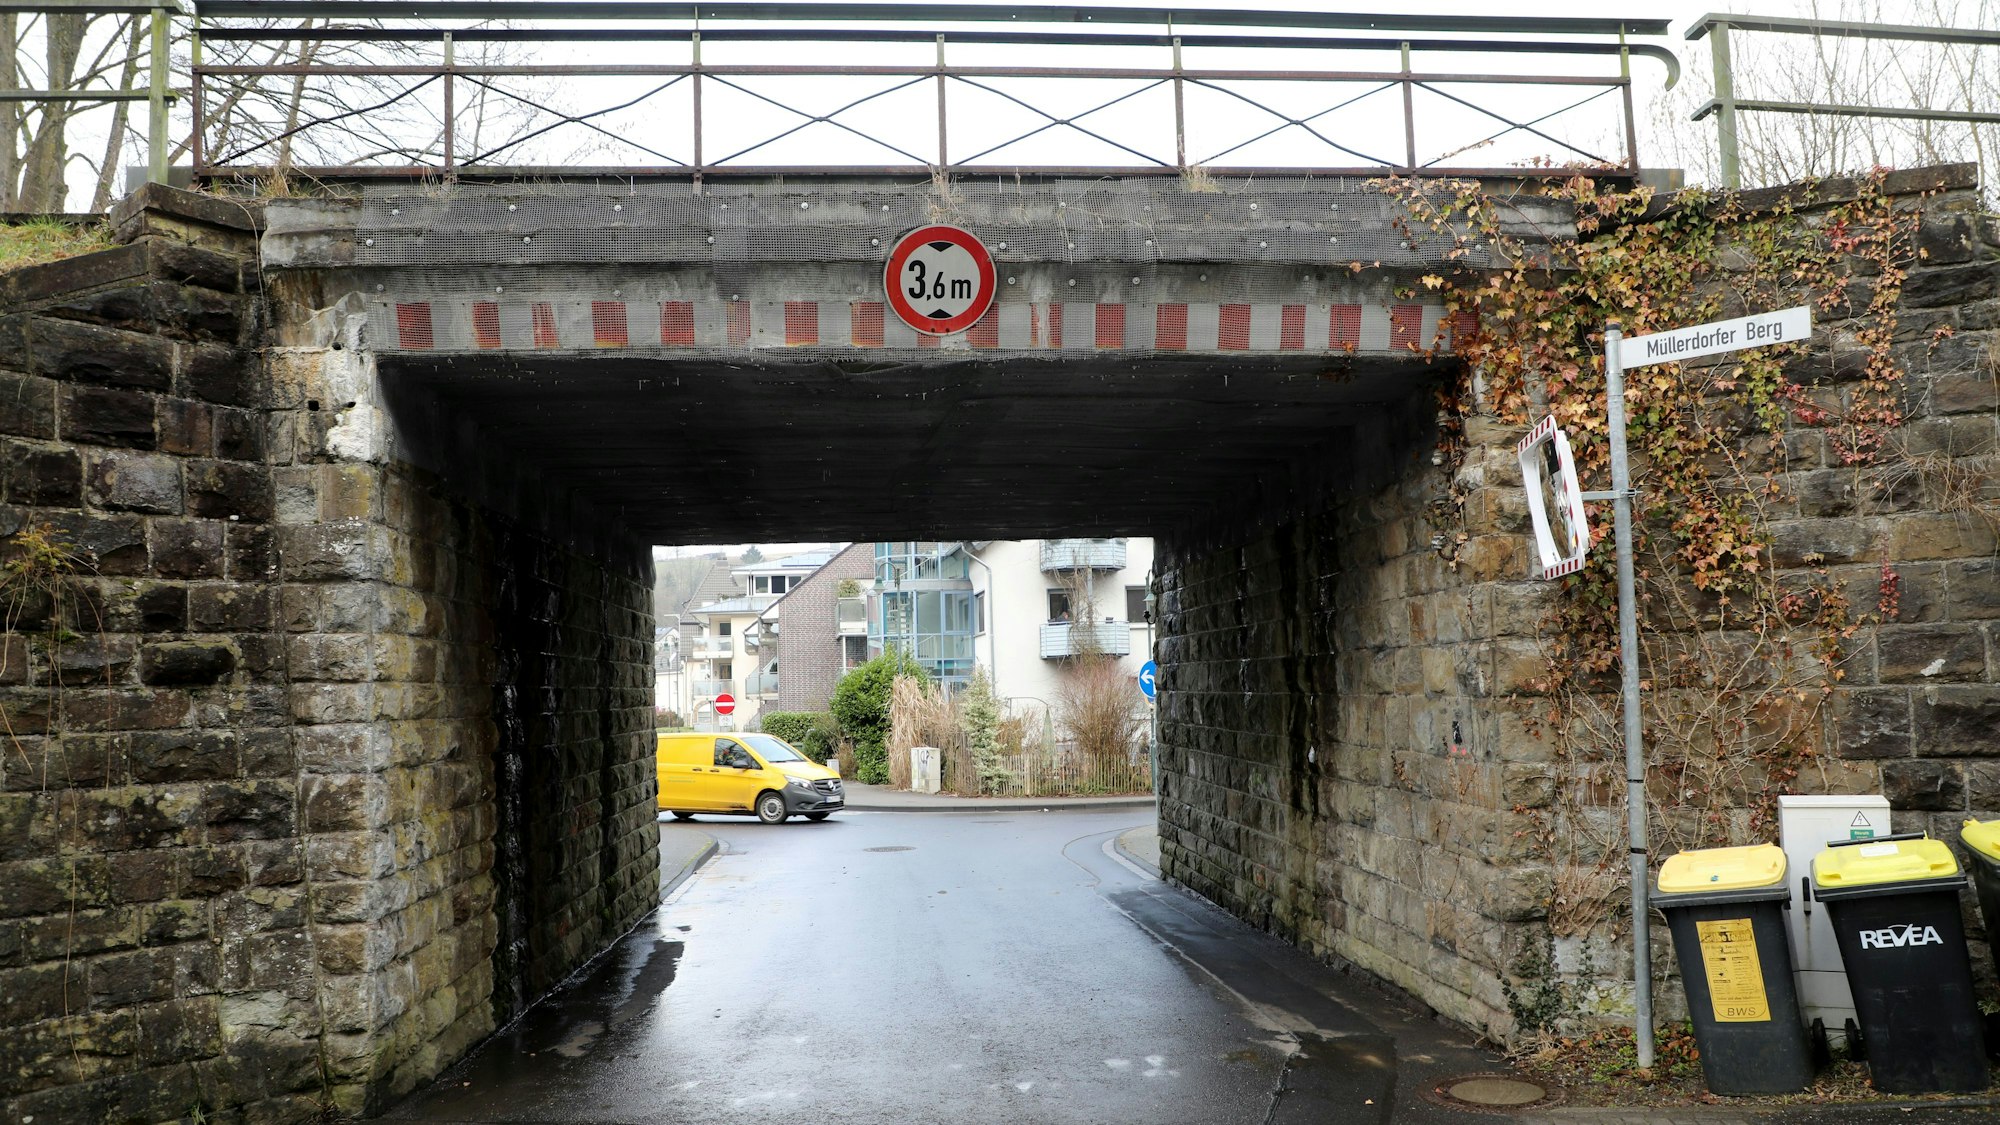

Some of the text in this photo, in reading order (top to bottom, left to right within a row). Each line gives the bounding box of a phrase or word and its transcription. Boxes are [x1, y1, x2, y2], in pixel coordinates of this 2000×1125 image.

[908, 259, 971, 301] 3,6 m
[1647, 321, 1783, 358] Müllerdorfer Berg
[1859, 923, 1944, 949] REVEA
[1727, 1007, 1756, 1016] BWS
